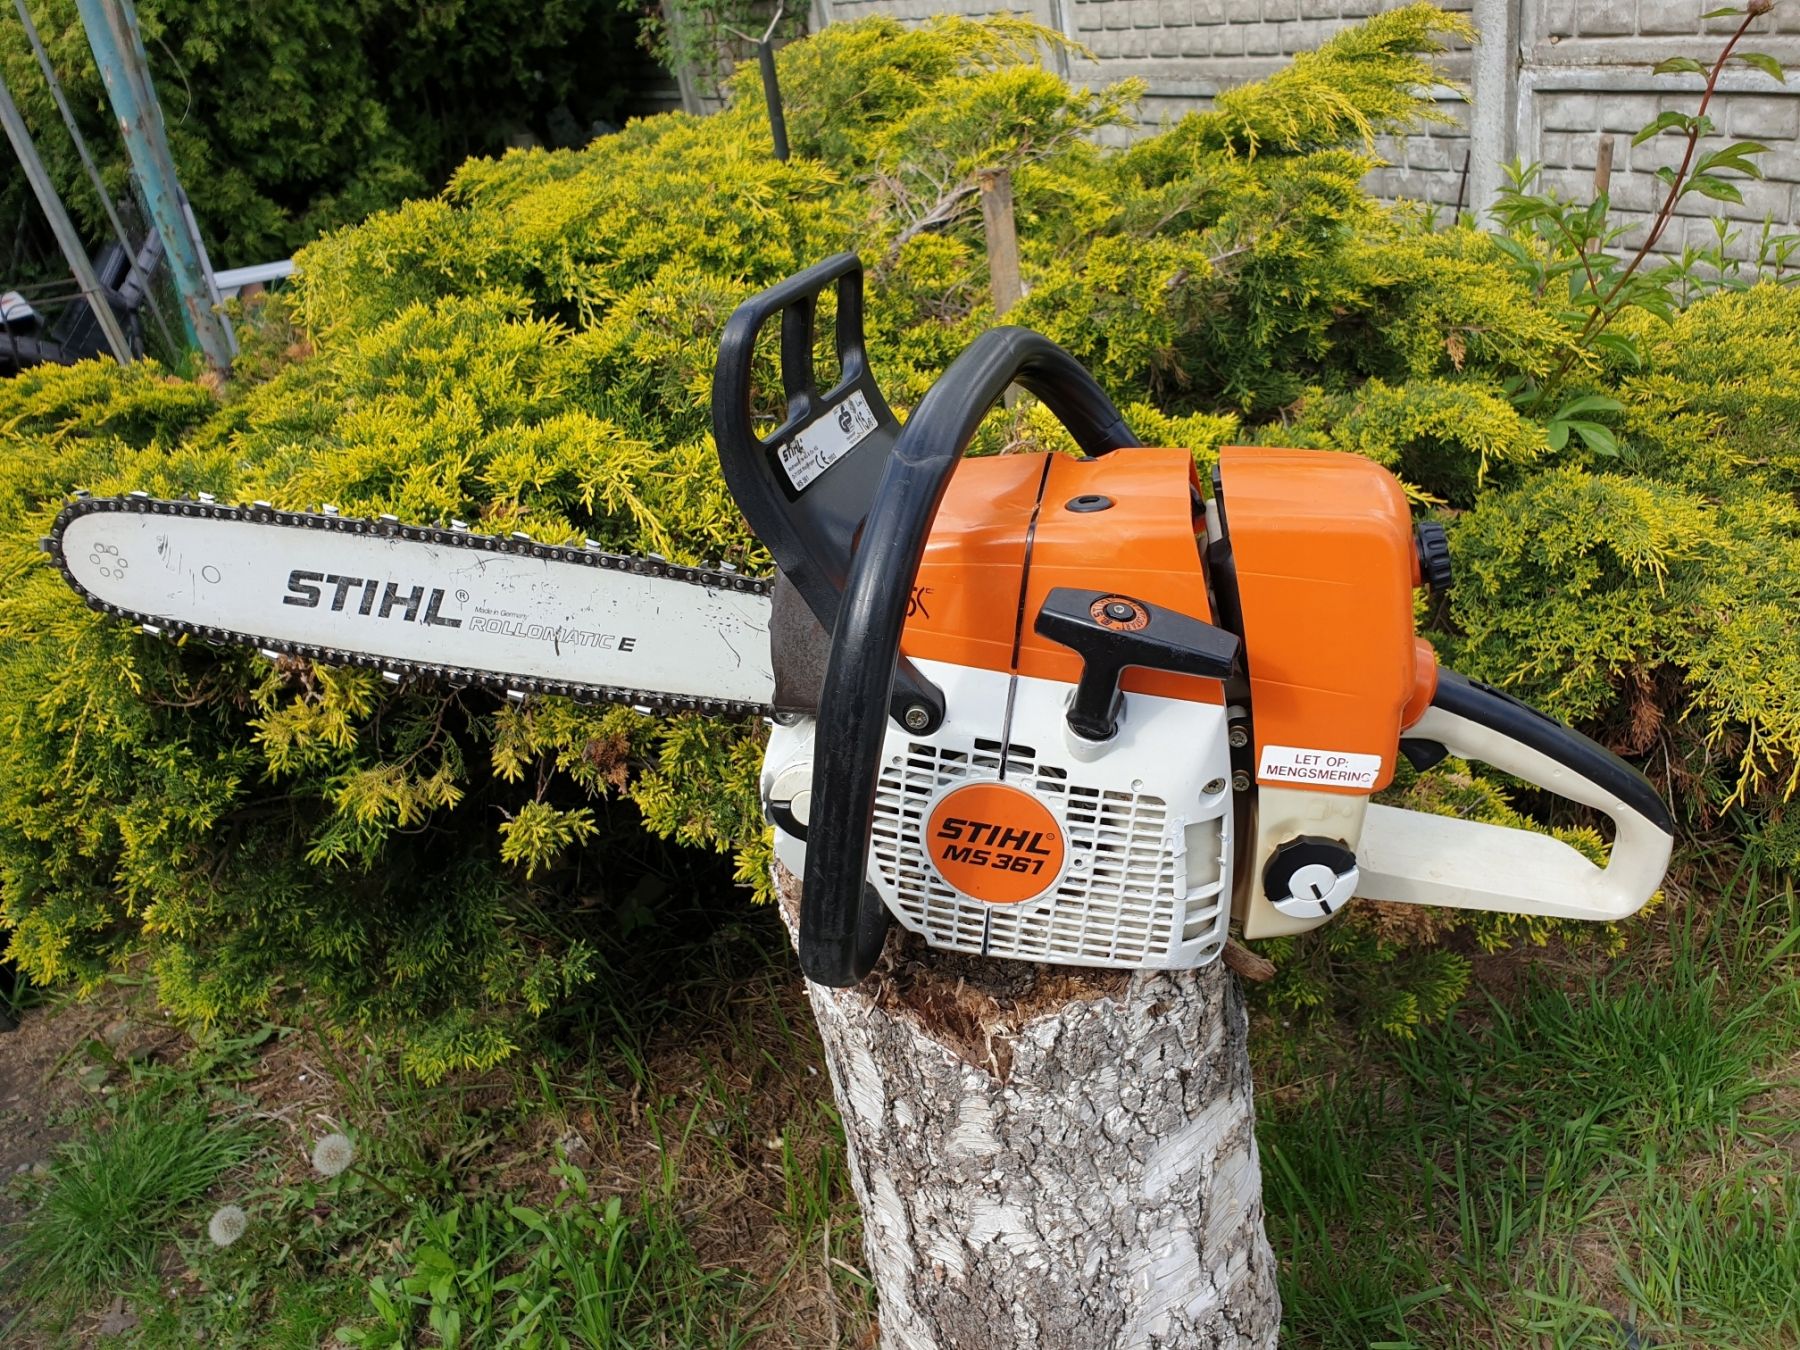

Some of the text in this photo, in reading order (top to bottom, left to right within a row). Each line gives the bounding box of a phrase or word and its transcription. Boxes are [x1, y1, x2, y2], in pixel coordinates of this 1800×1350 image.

[283, 569, 463, 629] STIHL
[474, 606, 528, 621] Made in Germany
[469, 616, 637, 653] ROLLOMATIC E
[1266, 764, 1372, 783] MENGSMERING
[1295, 754, 1349, 769] LET OP:
[936, 817, 1051, 856] STIHL
[942, 844, 1045, 875] MS 361
